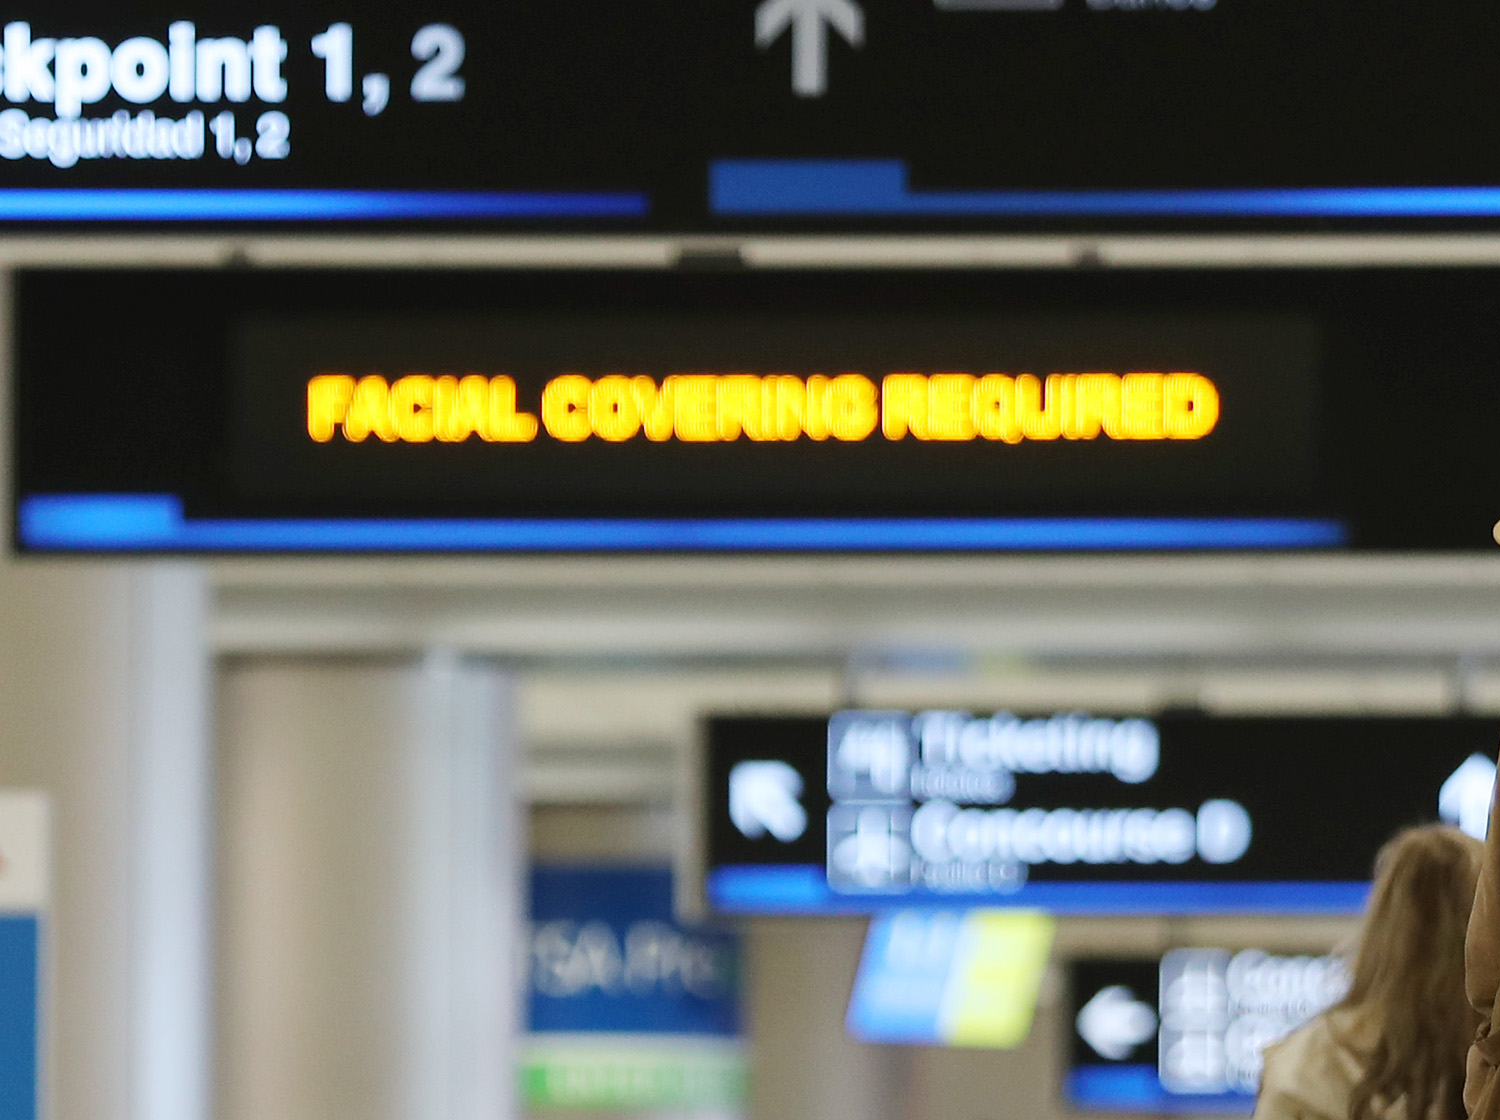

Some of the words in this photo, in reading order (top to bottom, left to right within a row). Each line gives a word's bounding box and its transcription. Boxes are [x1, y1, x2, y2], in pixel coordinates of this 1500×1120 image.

[0, 20, 288, 118] kpoint
[310, 21, 391, 118] 1,
[410, 22, 466, 102] 2
[0, 108, 205, 169] Seguridad
[255, 110, 290, 159] 2
[307, 374, 539, 443] FACIAL
[541, 374, 879, 443] COVERING
[881, 373, 1220, 444] REQUIRED
